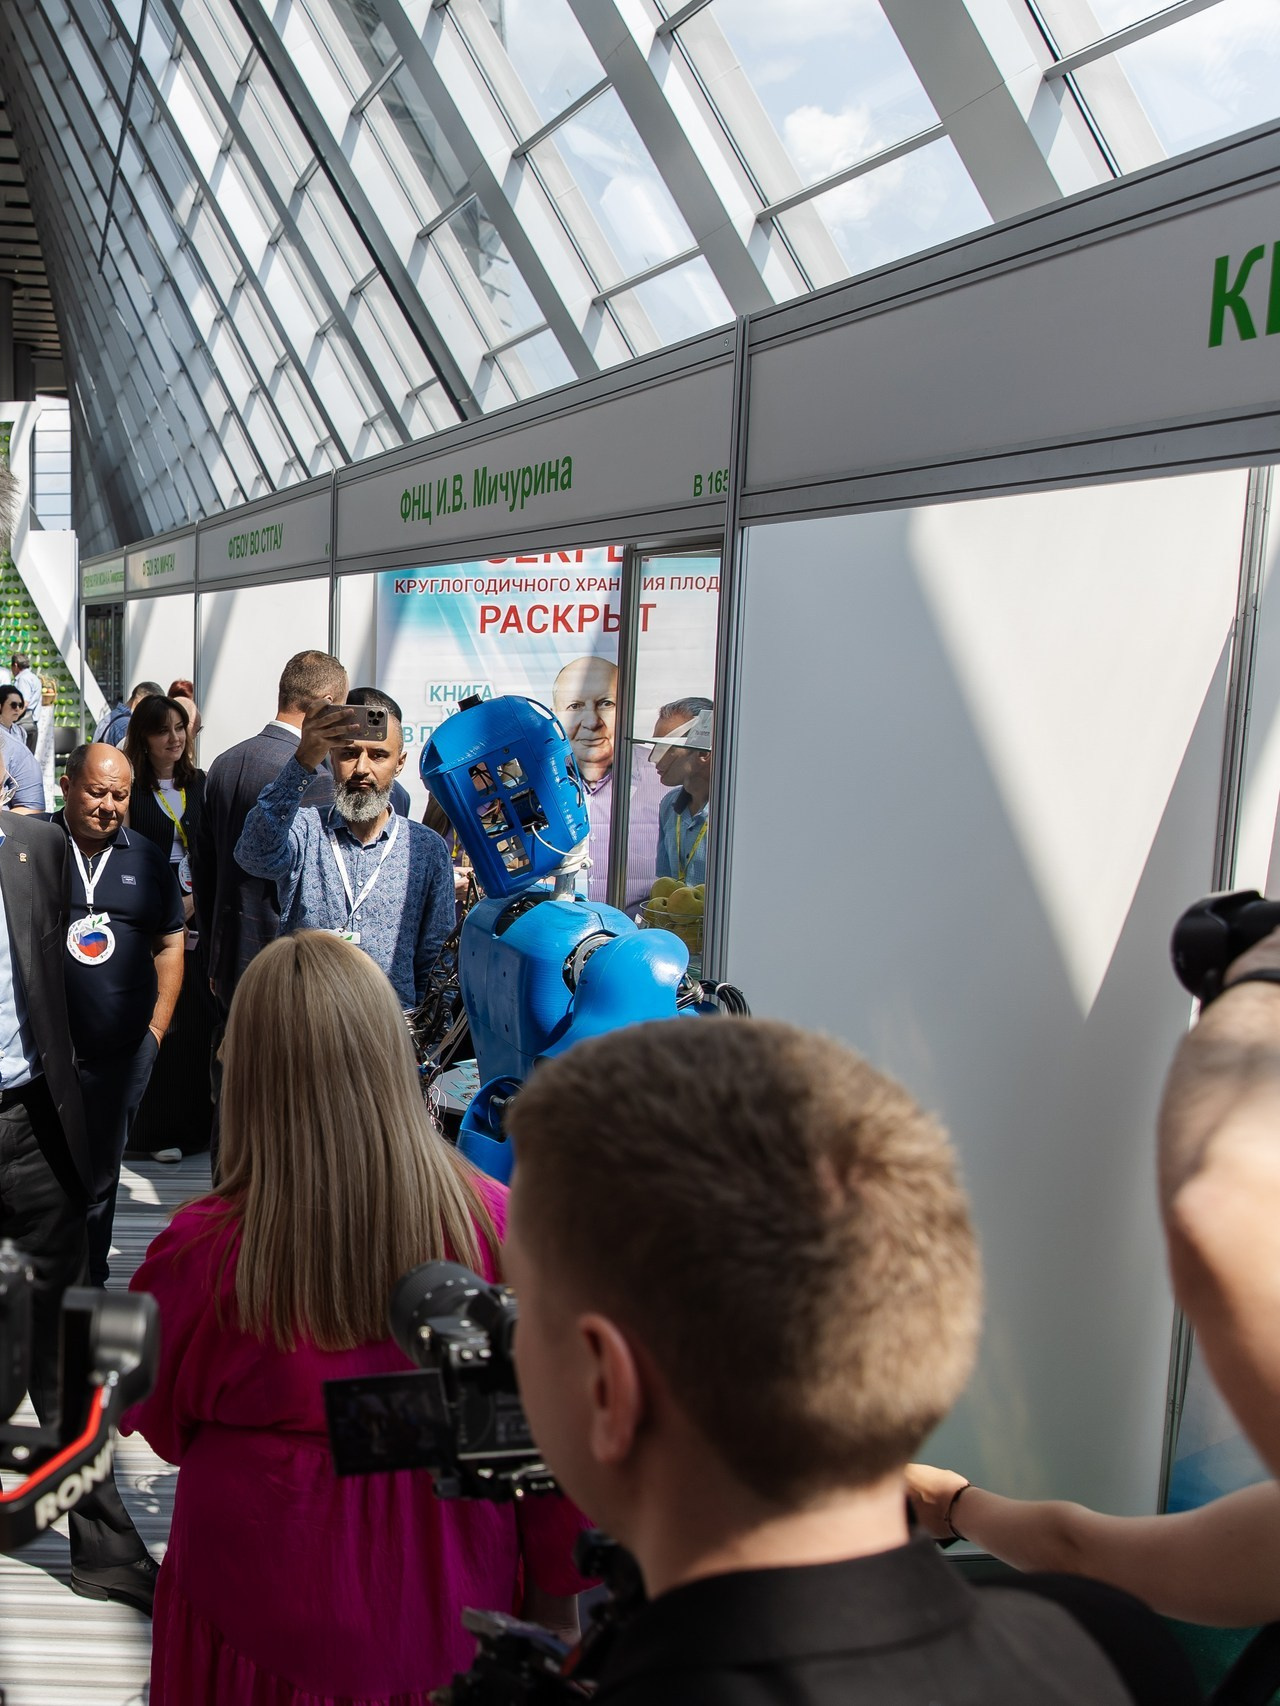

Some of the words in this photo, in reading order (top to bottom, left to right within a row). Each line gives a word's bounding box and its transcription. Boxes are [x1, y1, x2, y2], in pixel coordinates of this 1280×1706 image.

[400, 482, 432, 525] ФНЦ
[437, 474, 467, 516] И.В.
[473, 455, 573, 513] Мичурина
[250, 529, 260, 556] ВО
[394, 577, 570, 595] КРУГЛОГОДИЧНОГО
[575, 576, 665, 592] ХРАНИЯ
[430, 684, 493, 702] КНИГА
